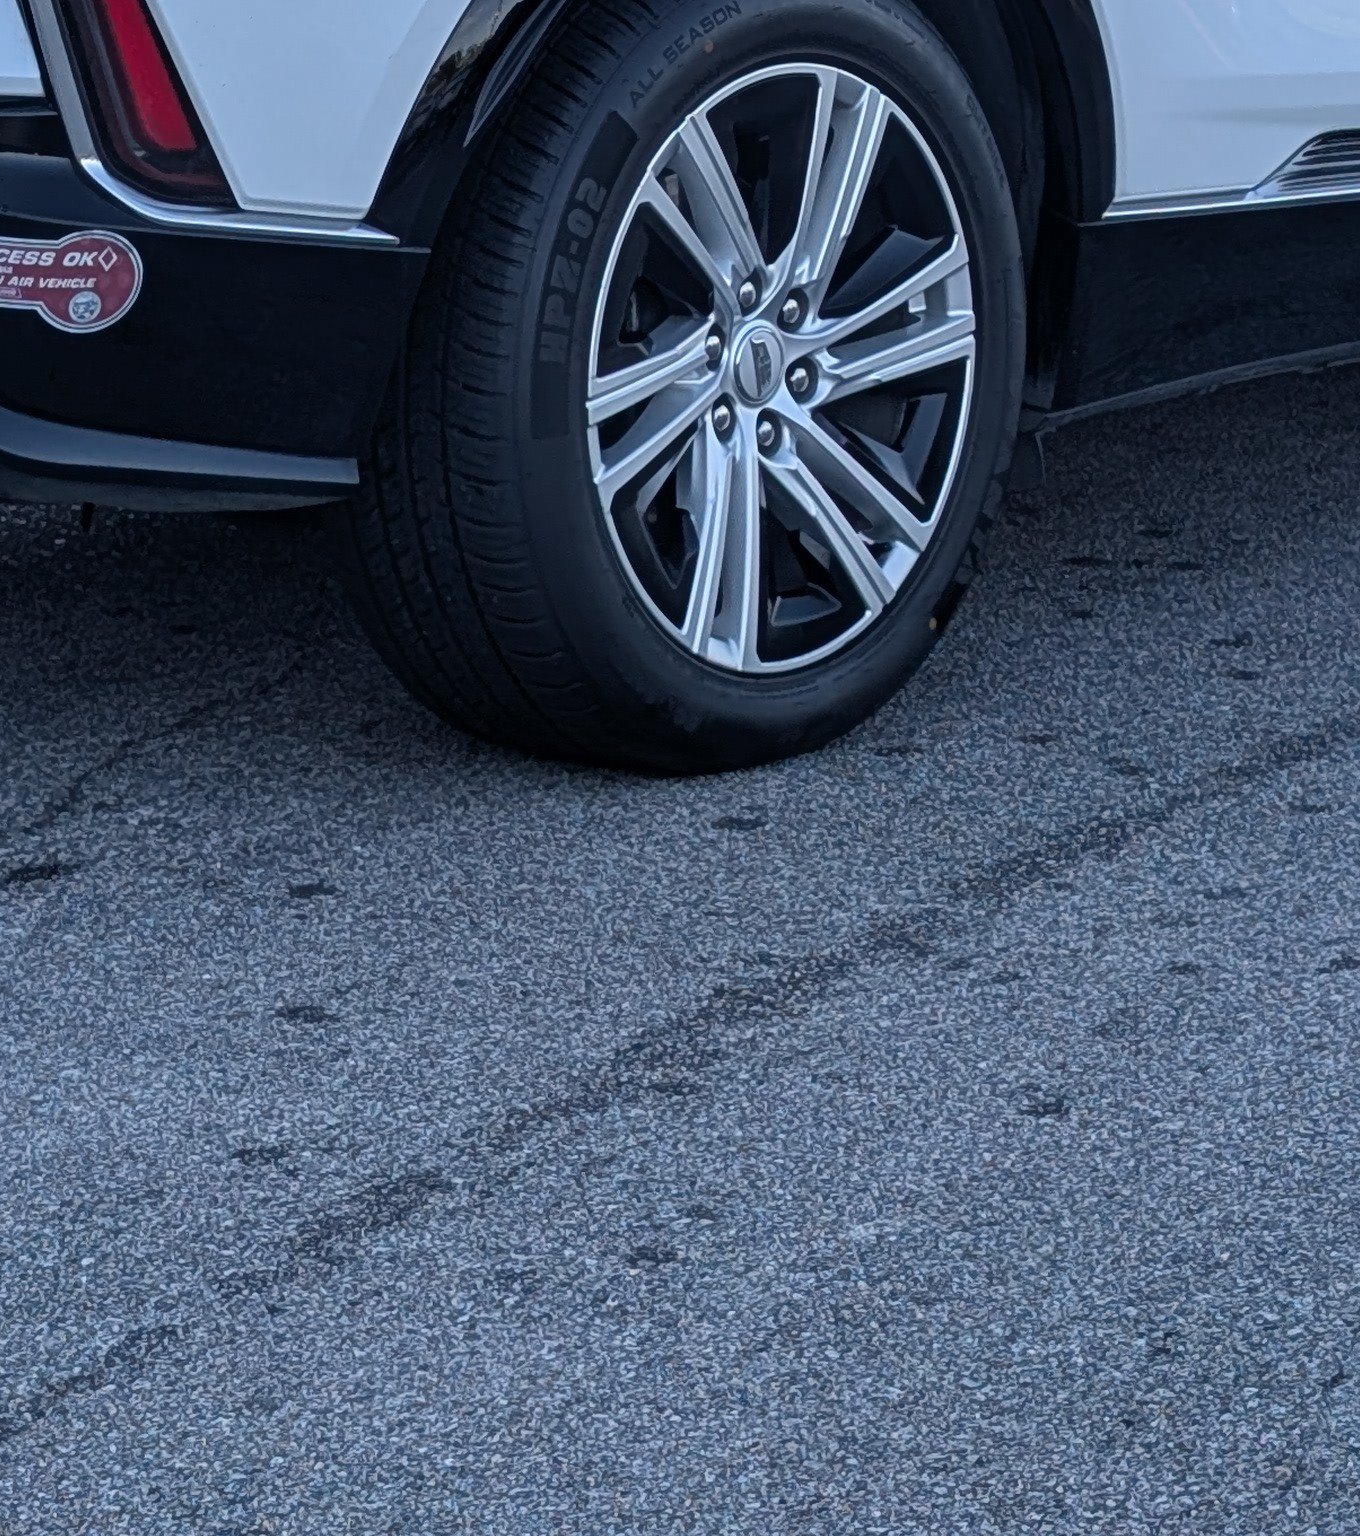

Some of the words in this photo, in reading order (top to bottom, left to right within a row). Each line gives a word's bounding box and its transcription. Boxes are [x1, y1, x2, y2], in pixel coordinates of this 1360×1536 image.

[629, 67, 664, 108] ALL
[662, 0, 742, 65] SEASON
[62, 251, 99, 267] OK
[7, 276, 35, 288] AIR
[38, 277, 97, 289] VEHICLE
